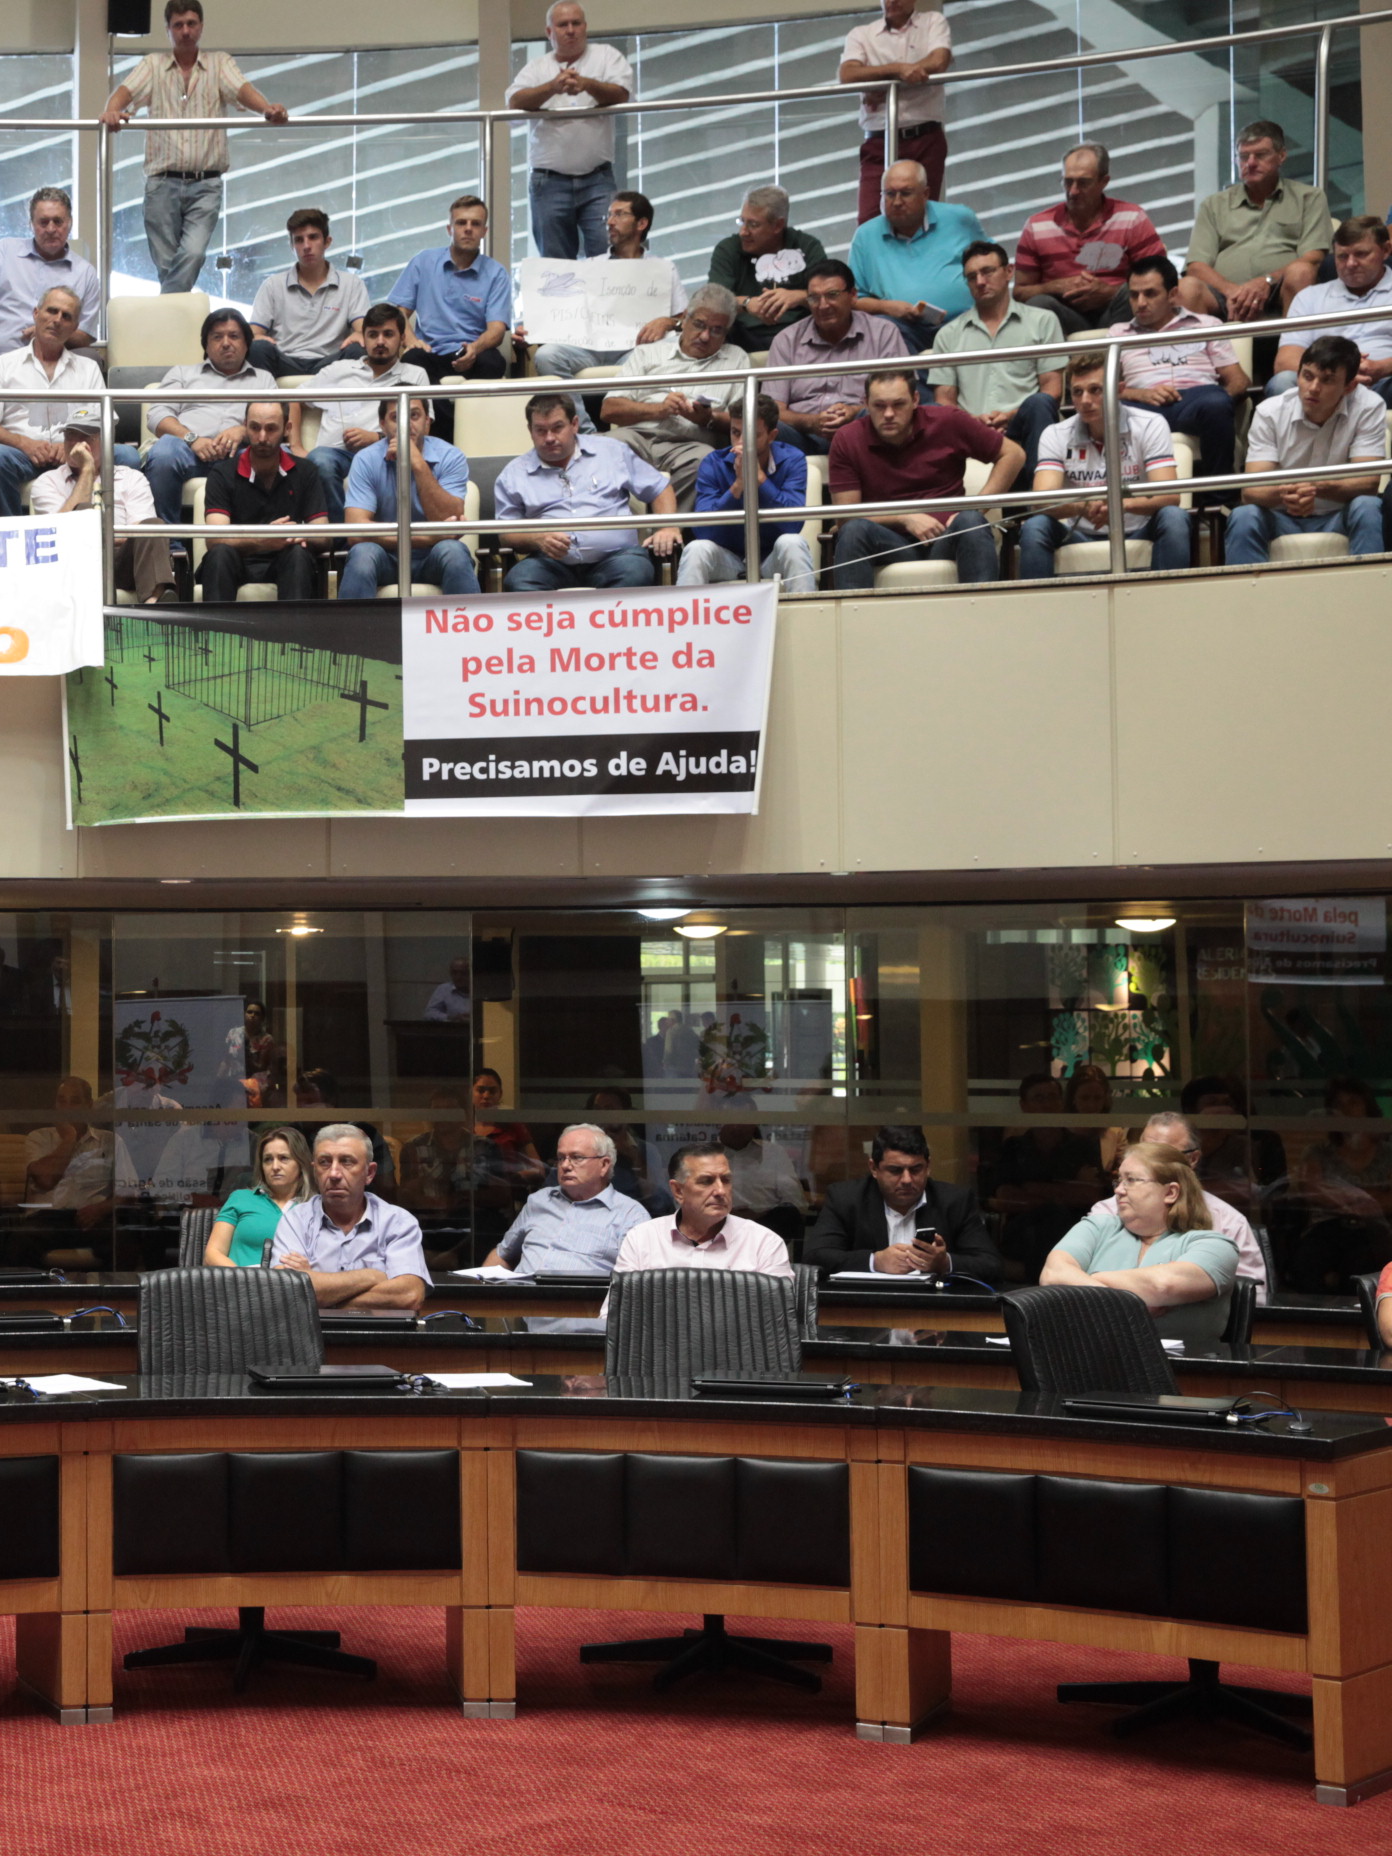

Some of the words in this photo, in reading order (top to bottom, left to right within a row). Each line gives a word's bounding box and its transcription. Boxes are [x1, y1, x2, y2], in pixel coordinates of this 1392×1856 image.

[424, 606, 494, 634] Não
[507, 603, 576, 637] seja
[589, 598, 753, 633] cúmplice
[461, 648, 536, 682] pela
[549, 645, 659, 673] Morte
[671, 642, 716, 669] da
[467, 687, 709, 718] Suinocultura.
[422, 754, 598, 781] Precisamos
[608, 751, 647, 777] de
[656, 748, 757, 781] Ajuda!
